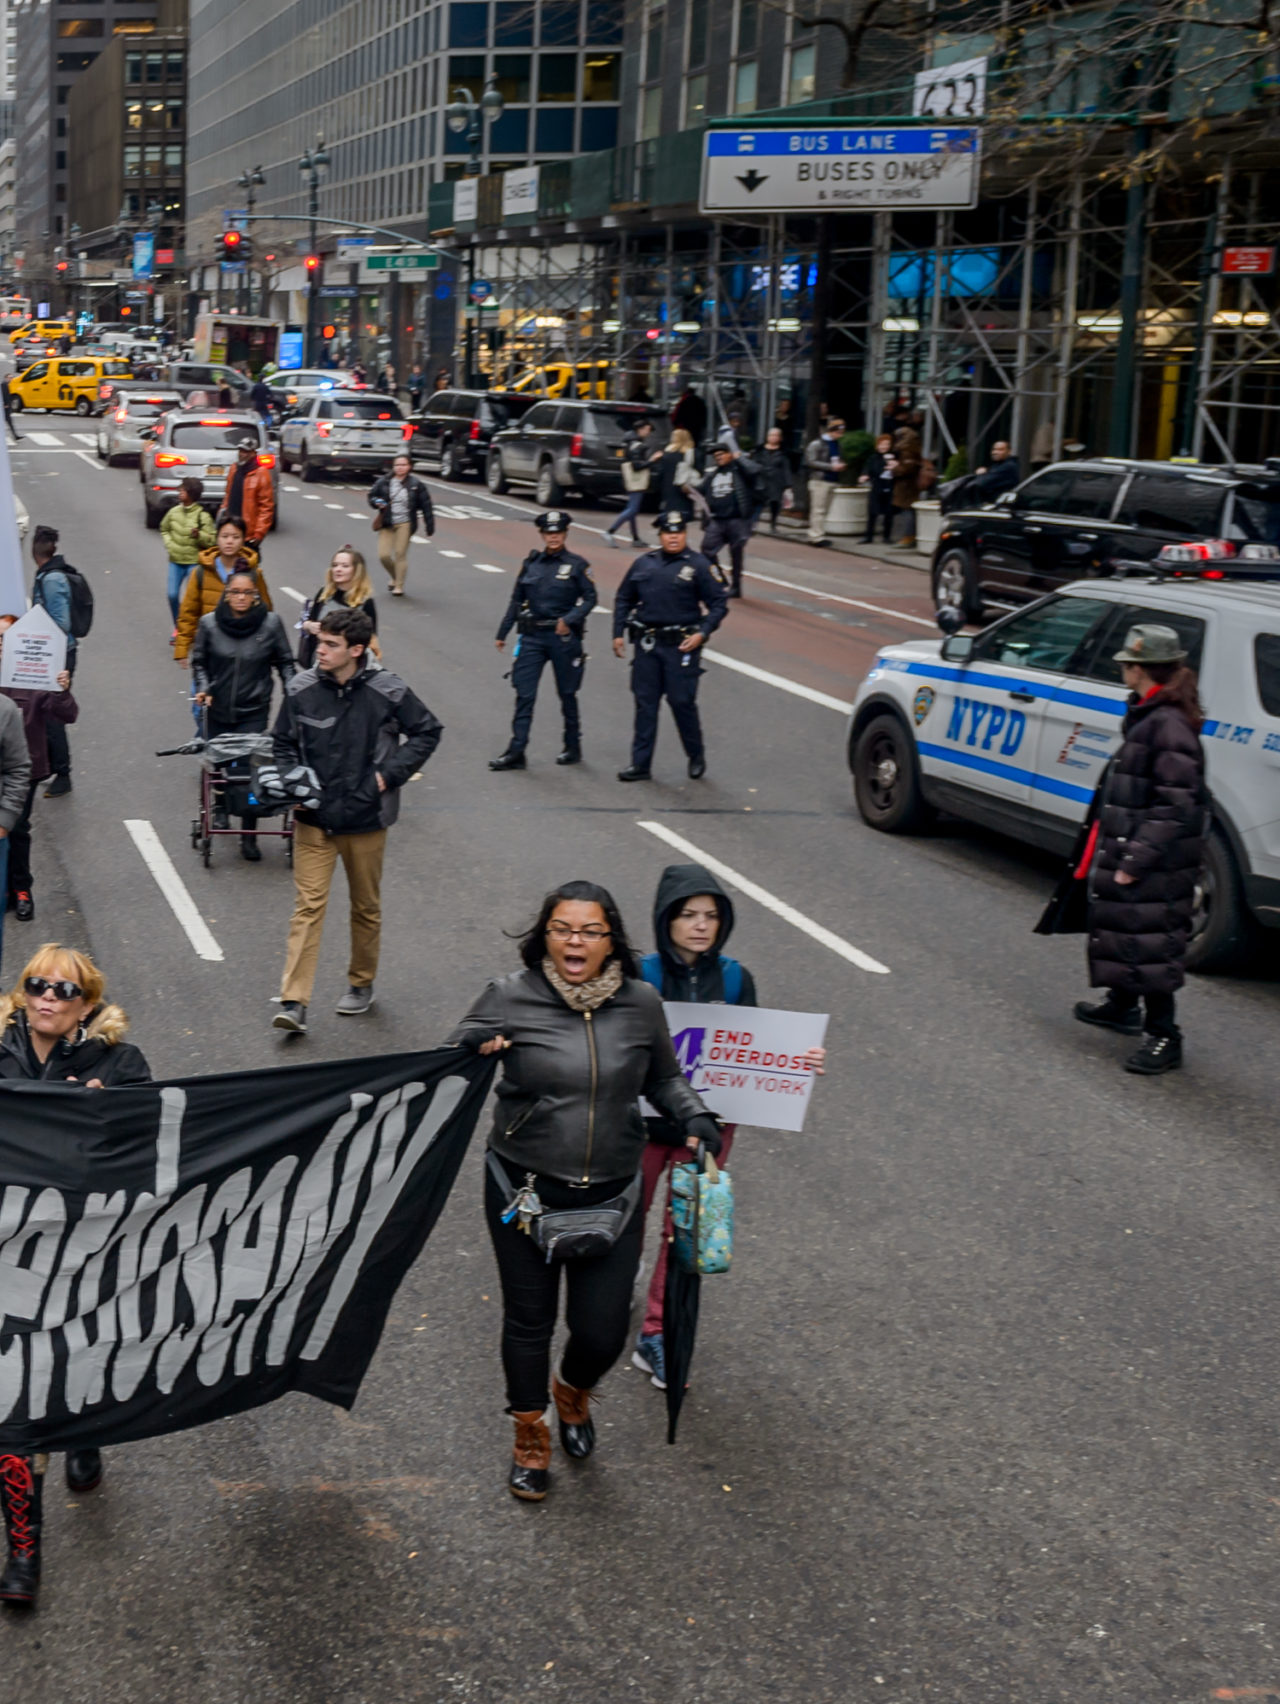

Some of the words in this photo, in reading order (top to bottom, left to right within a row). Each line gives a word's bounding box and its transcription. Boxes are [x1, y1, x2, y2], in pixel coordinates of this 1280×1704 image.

[789, 135, 829, 151] BUS
[842, 134, 897, 150] LANE
[797, 162, 875, 182] BUSES
[883, 161, 945, 181] ONLY
[832, 189, 871, 200] RIGHT
[877, 188, 923, 200] TURNS
[946, 695, 1027, 757] NYPD
[711, 1029, 754, 1046] END
[701, 1070, 750, 1088] NEW
[753, 1075, 809, 1096] YORK
